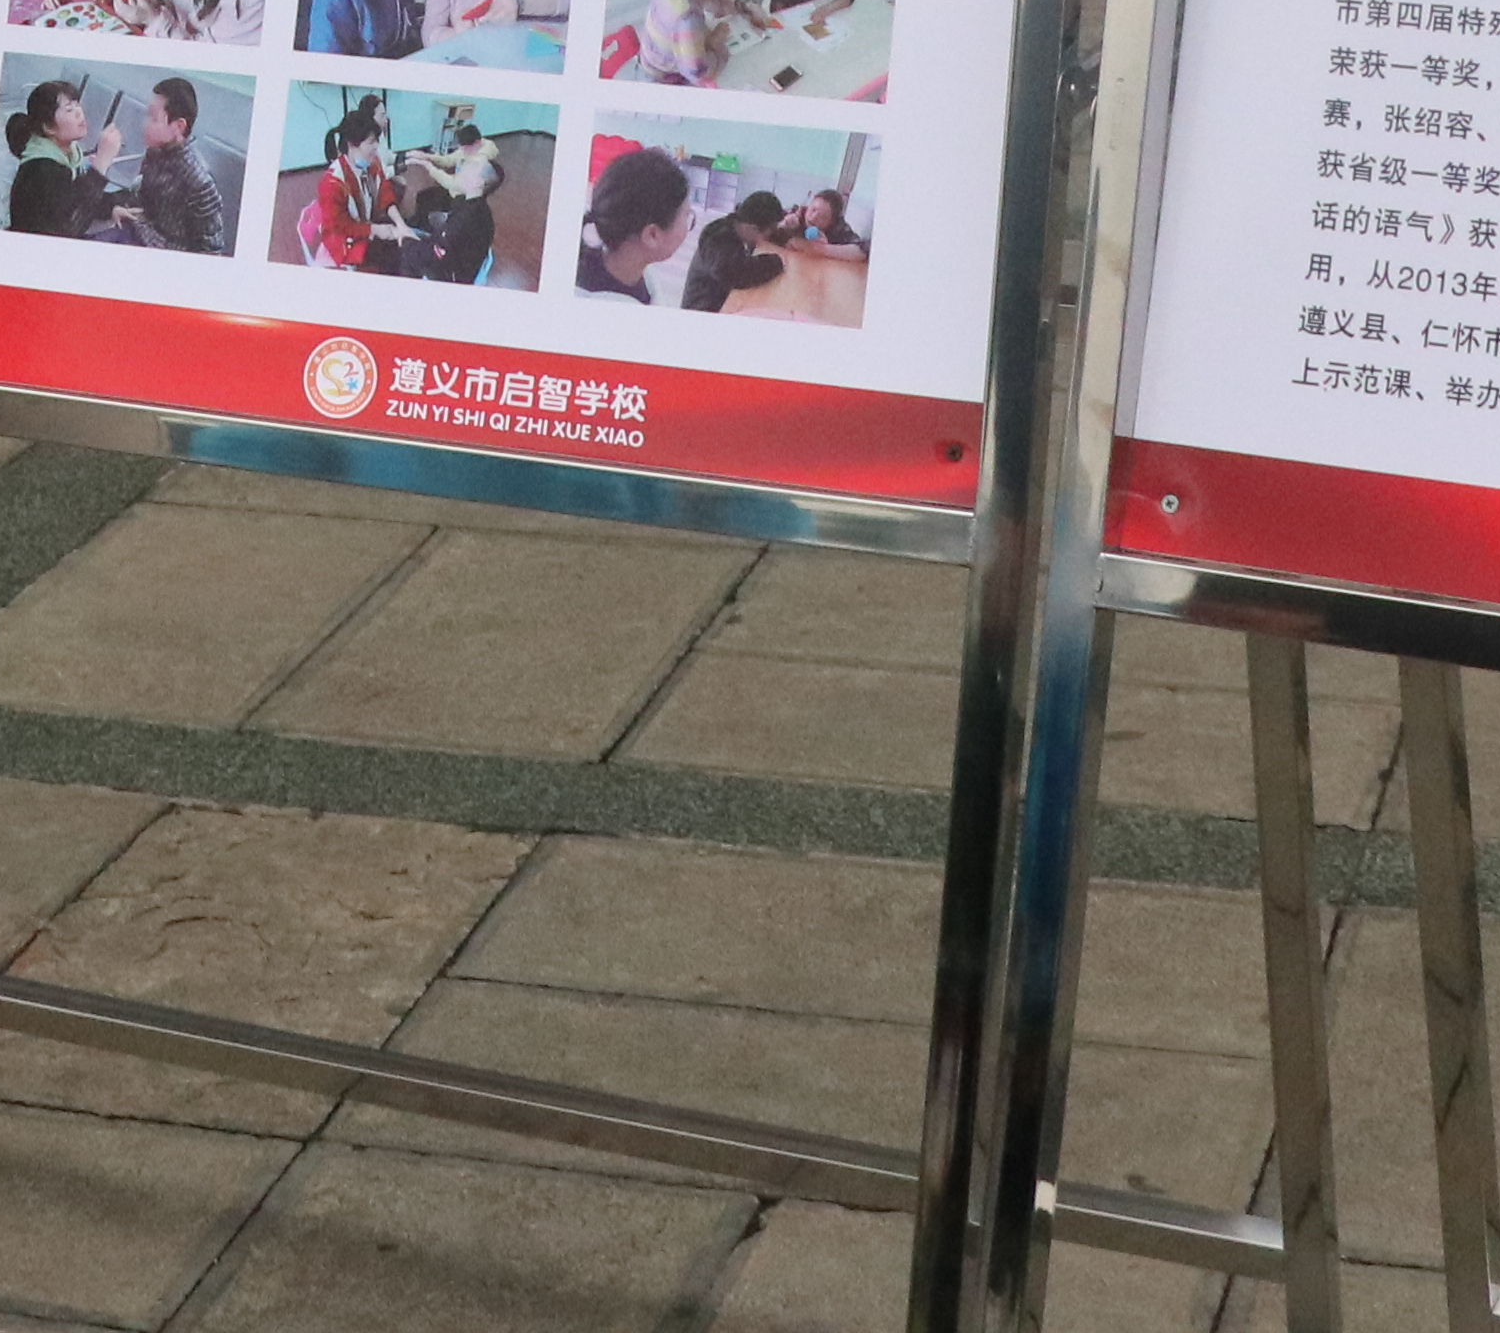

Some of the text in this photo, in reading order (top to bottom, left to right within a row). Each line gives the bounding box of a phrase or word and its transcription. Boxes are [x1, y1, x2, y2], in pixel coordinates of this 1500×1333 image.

[389, 356, 649, 423] 遵义市启智学校
[386, 399, 644, 448] ZUN YI SHI QI ZHI XUE XIAO
